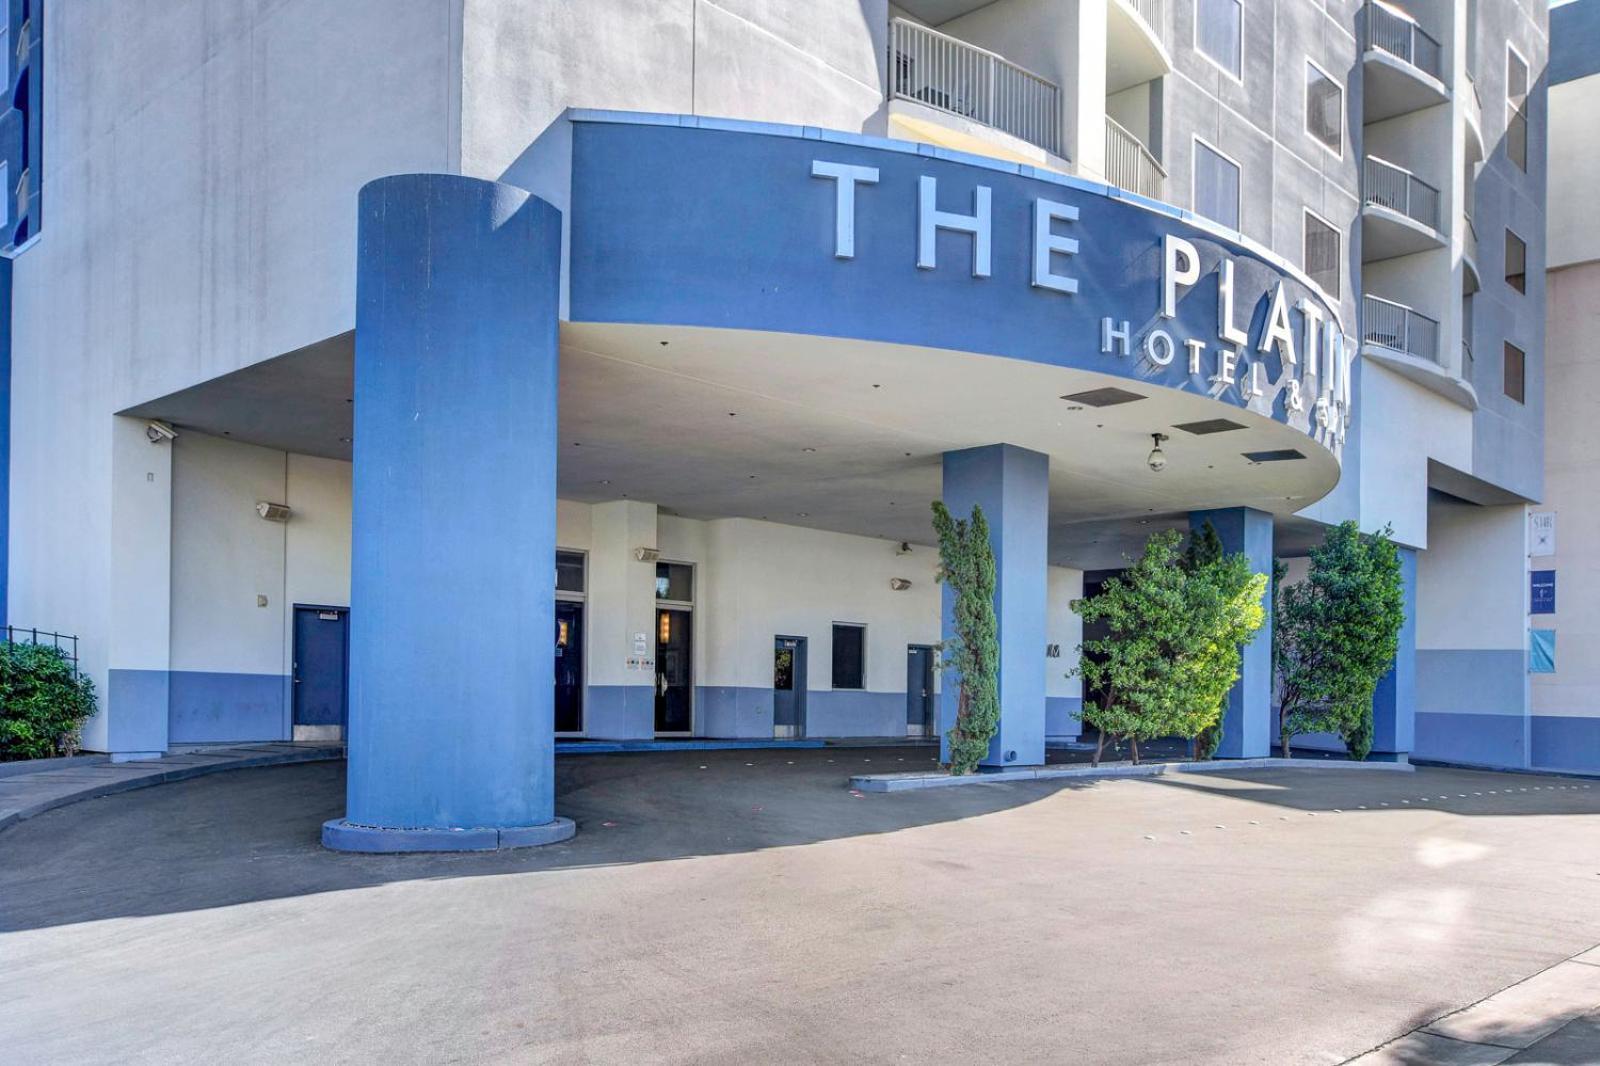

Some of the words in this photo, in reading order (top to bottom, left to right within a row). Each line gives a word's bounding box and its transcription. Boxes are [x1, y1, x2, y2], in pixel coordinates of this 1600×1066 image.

[812, 160, 1080, 294] THE
[1101, 316, 1262, 400] HOTEL
[1285, 378, 1304, 414] &
